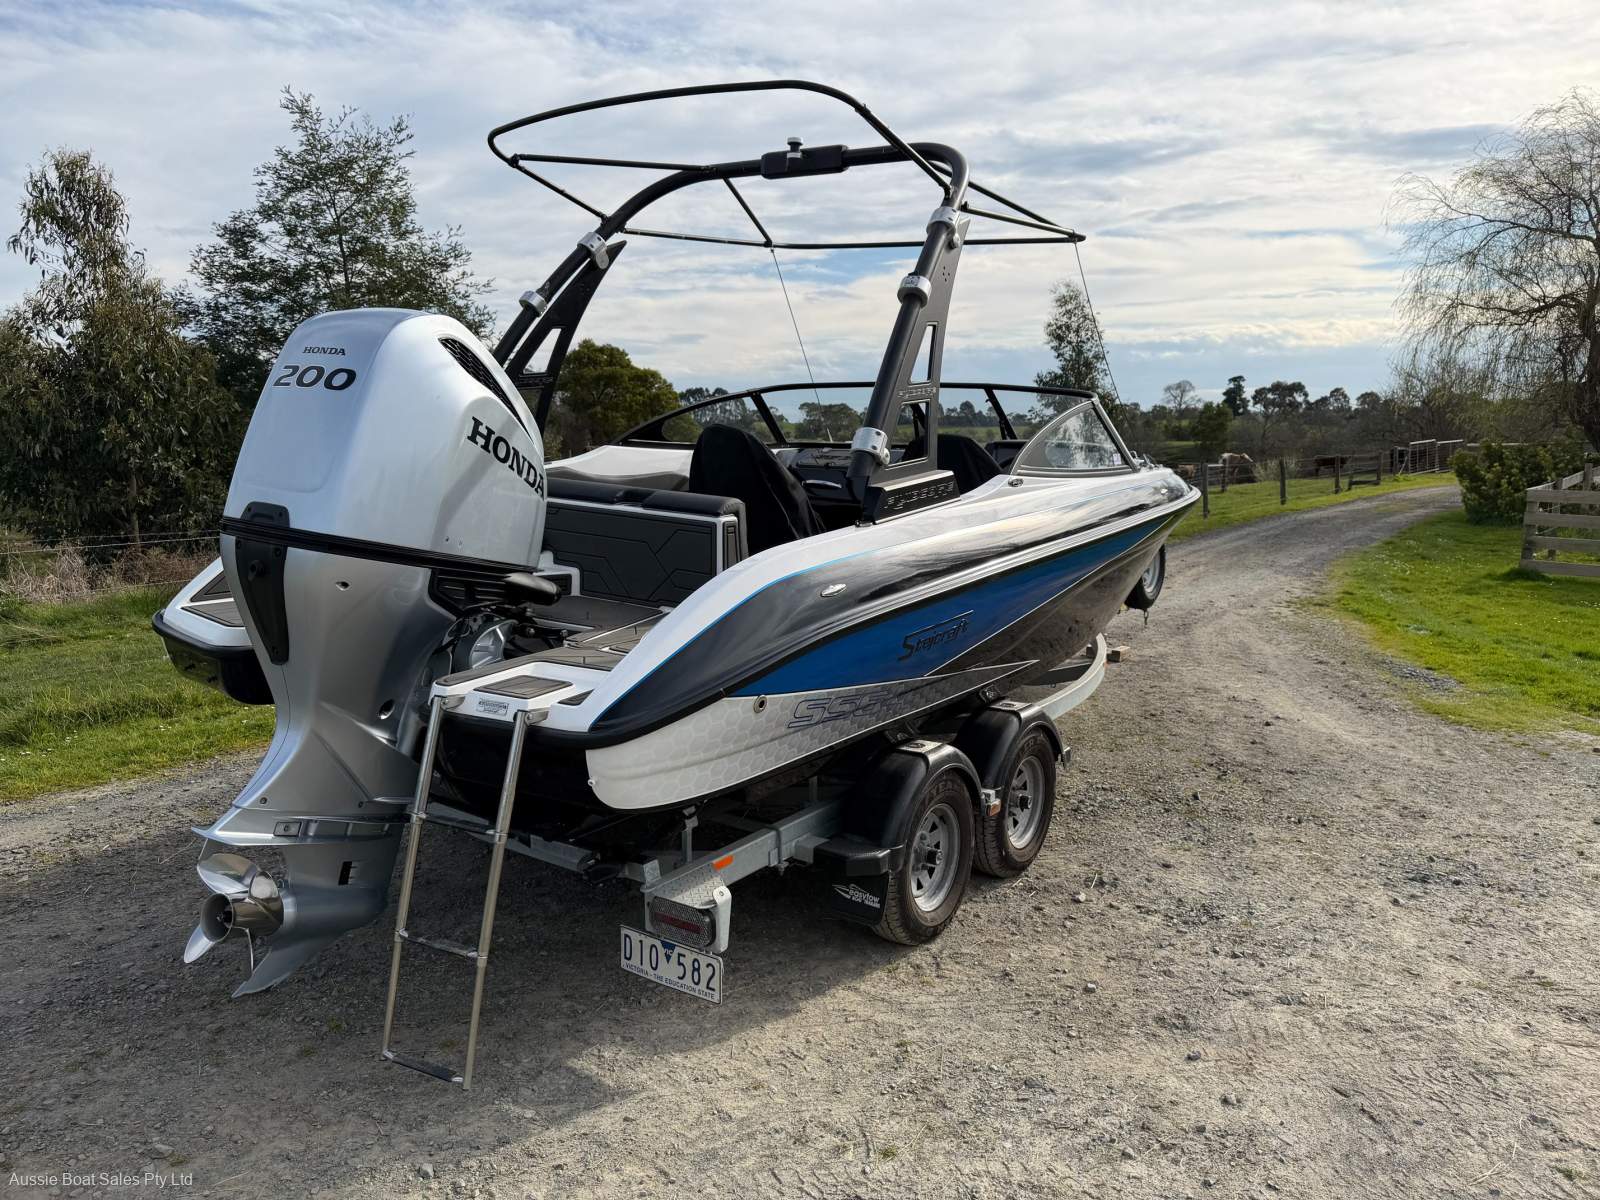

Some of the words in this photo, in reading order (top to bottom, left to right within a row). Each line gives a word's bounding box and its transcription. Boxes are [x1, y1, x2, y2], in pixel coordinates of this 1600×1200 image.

[302, 345, 347, 357] HONDA
[272, 364, 357, 391] 200
[466, 416, 545, 500] HONDA
[625, 962, 648, 976] VICTORIA
[653, 973, 664, 983] THE
[664, 978, 696, 992] EDUCATION
[697, 989, 715, 1000] STATE
[677, 952, 715, 992] 582
